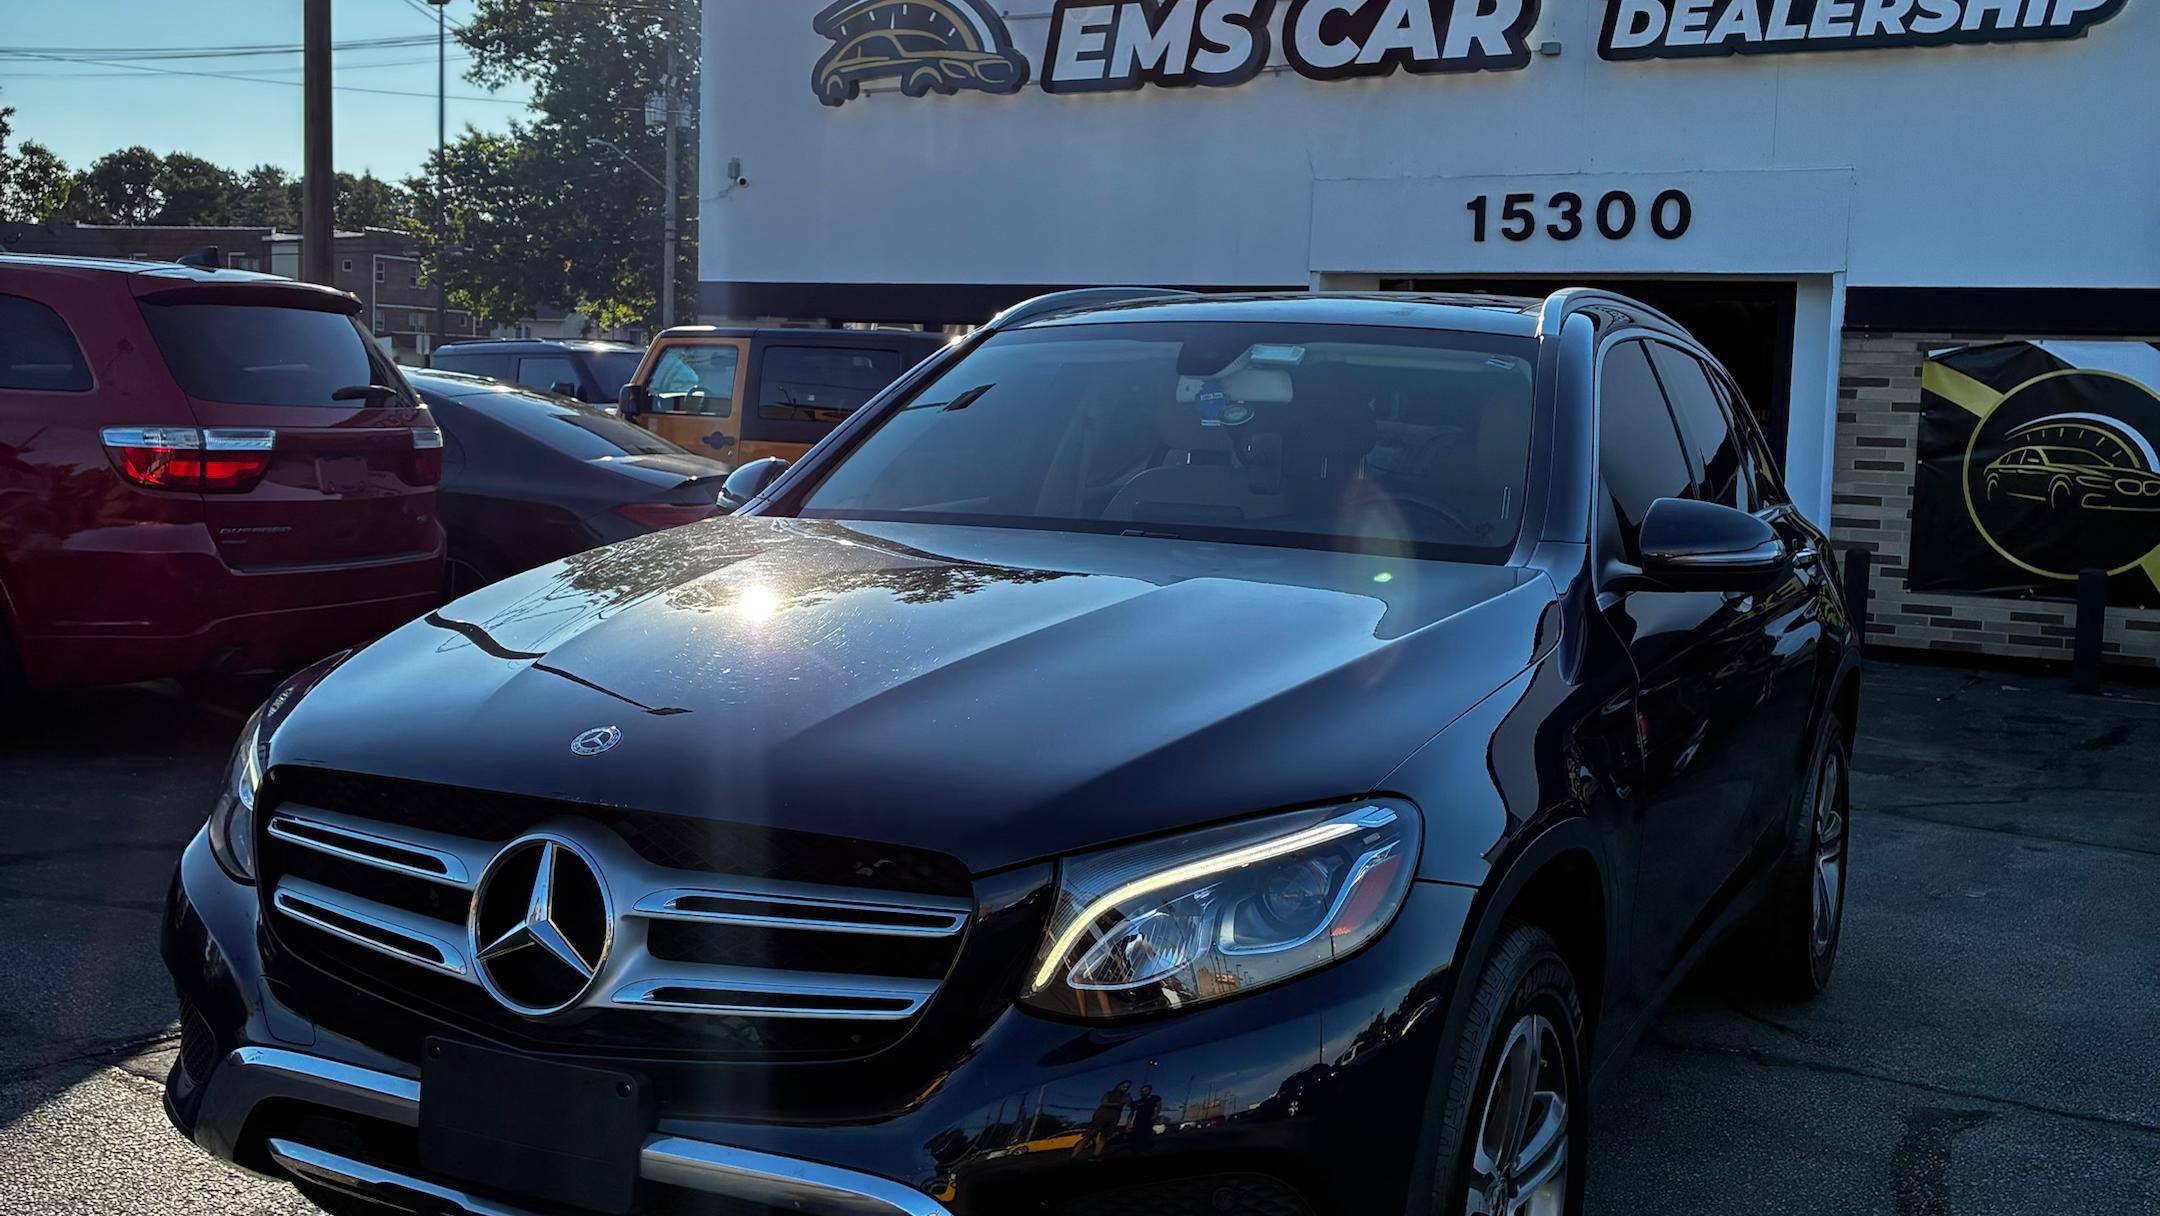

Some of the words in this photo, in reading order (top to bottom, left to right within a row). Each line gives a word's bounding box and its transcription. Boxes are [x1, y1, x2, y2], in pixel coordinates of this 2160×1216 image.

[1051, 0, 1260, 81] EMS
[1294, 0, 1522, 69] CAR
[1466, 189, 1692, 242] 15300
